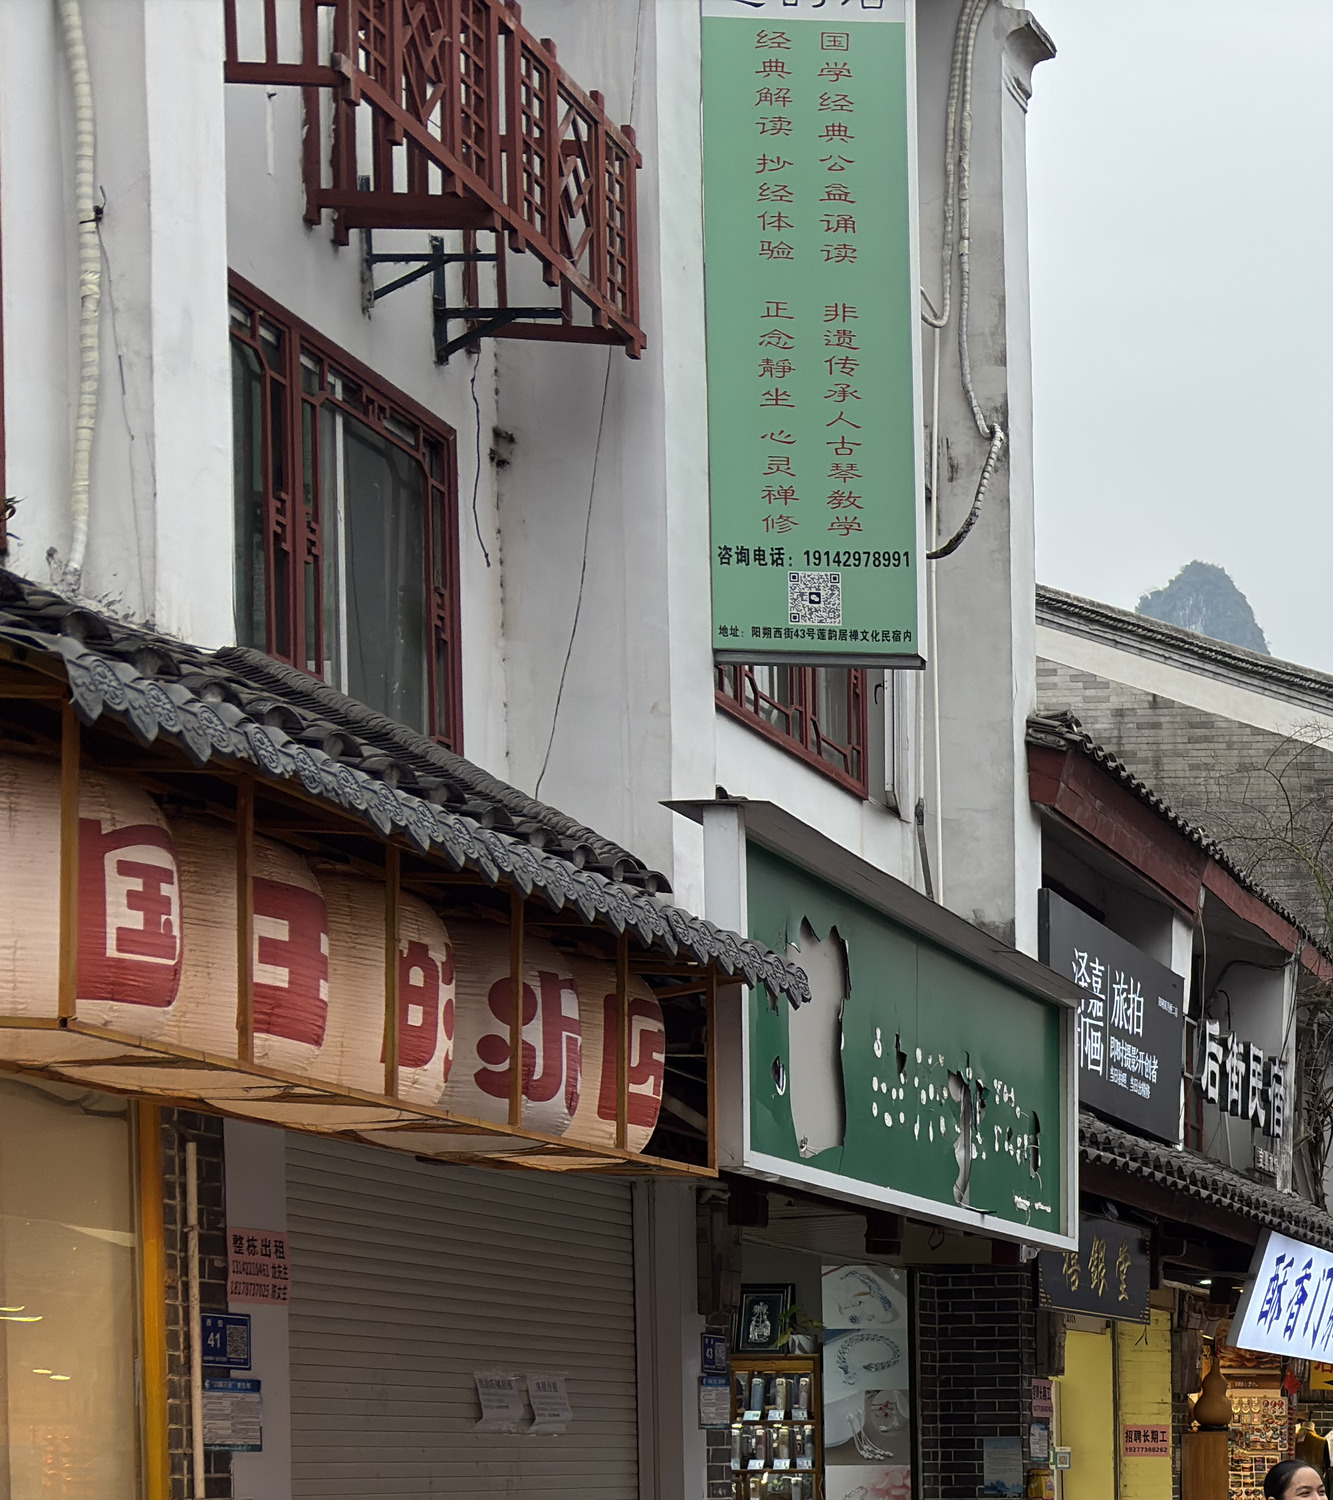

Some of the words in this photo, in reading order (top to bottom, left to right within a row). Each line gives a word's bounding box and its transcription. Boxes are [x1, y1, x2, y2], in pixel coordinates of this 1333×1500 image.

[755, 30, 793, 136] 经典解读
[817, 32, 858, 263] 国学经典公益诵读
[755, 153, 794, 261] 抄经体验
[823, 302, 864, 536] 非遗传承人古琴教学
[760, 429, 800, 534] 心灵禅修
[803, 550, 911, 568] 19142978991
[1111, 970, 1145, 1037] 旅拍
[231, 1234, 286, 1260] 整栋出租
[207, 1332, 221, 1348] 41
[1125, 1430, 1168, 1443] 招聘长期工
